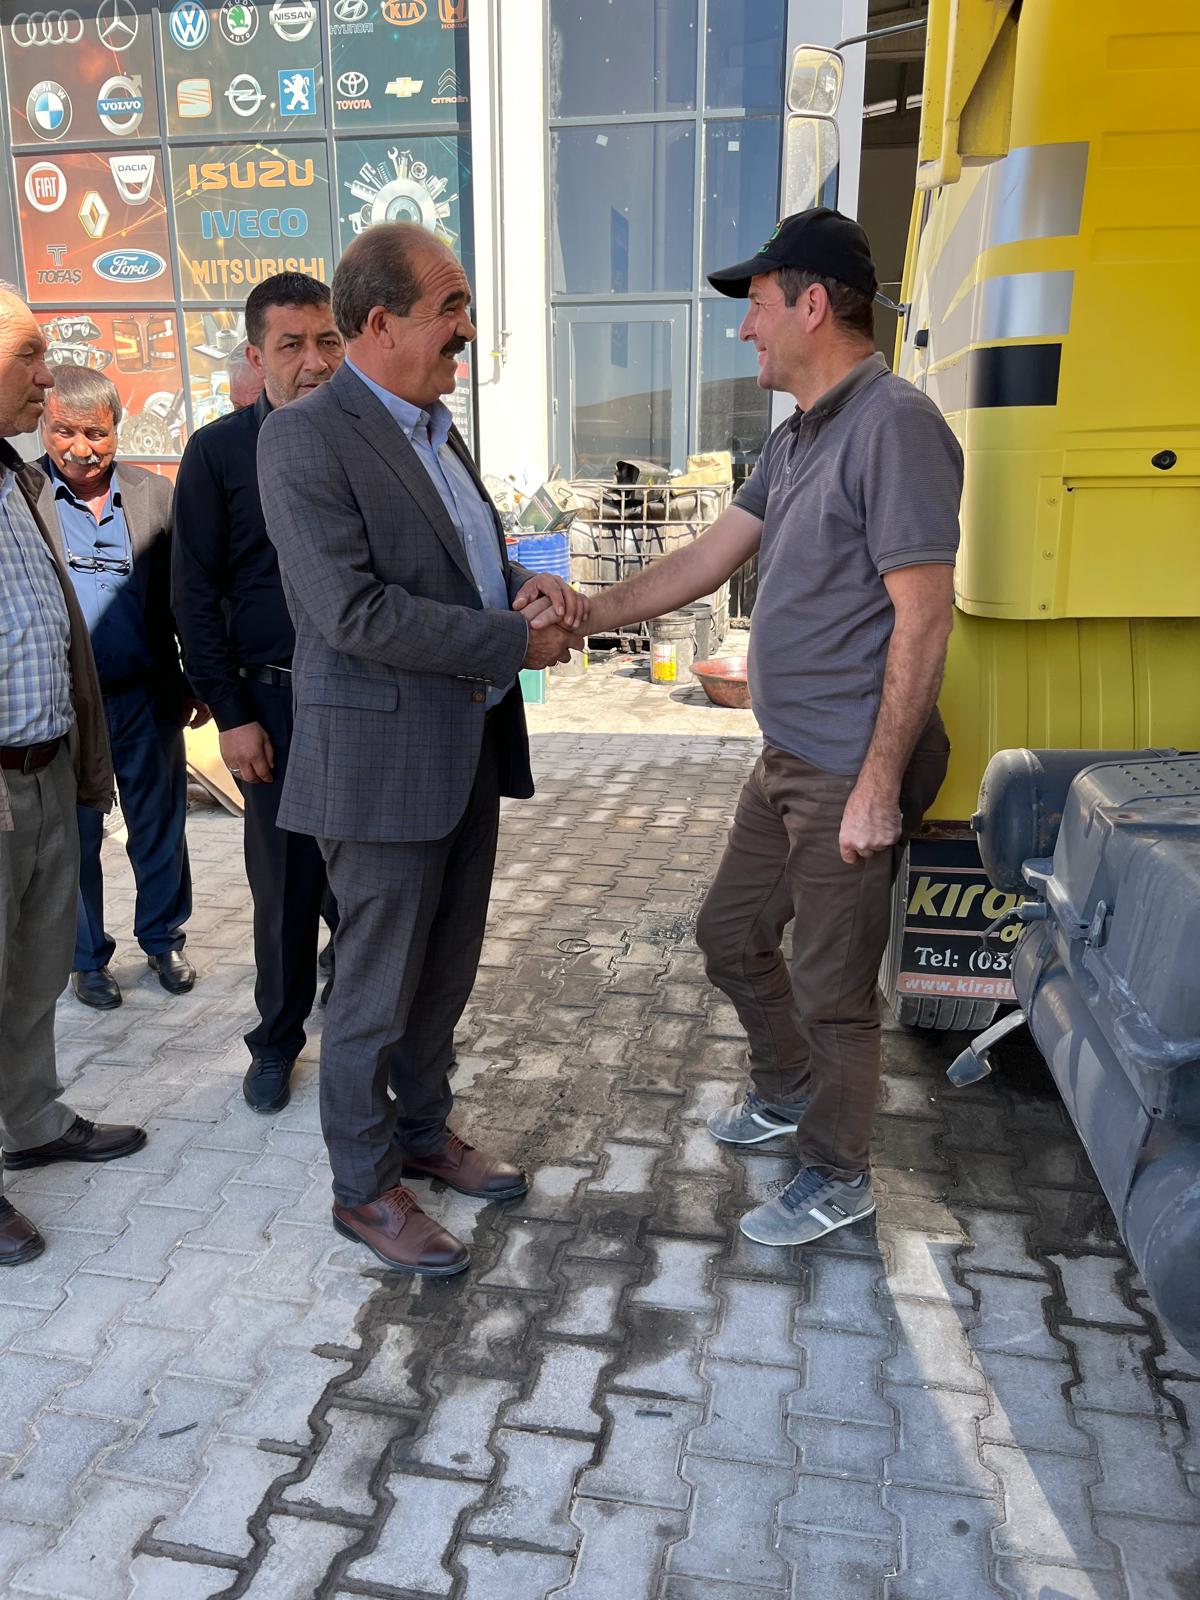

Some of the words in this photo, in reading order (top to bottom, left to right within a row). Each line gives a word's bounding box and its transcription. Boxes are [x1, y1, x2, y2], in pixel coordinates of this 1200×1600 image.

[274, 11, 312, 21] NISSAN
[389, 3, 420, 19] KIA
[329, 22, 374, 35] HYUNDAI
[230, 32, 250, 42] AUTO
[31, 83, 67, 101] BMW
[100, 101, 141, 111] VOLVO
[336, 99, 372, 110] TOYOTA
[118, 164, 147, 172] DACIA
[188, 159, 314, 190] ISUZU
[35, 176, 57, 198] FIAT
[200, 208, 308, 239] IVECO
[110, 255, 149, 276] Ford
[914, 946, 958, 968] Tel:
[968, 950, 1013, 972] (03
